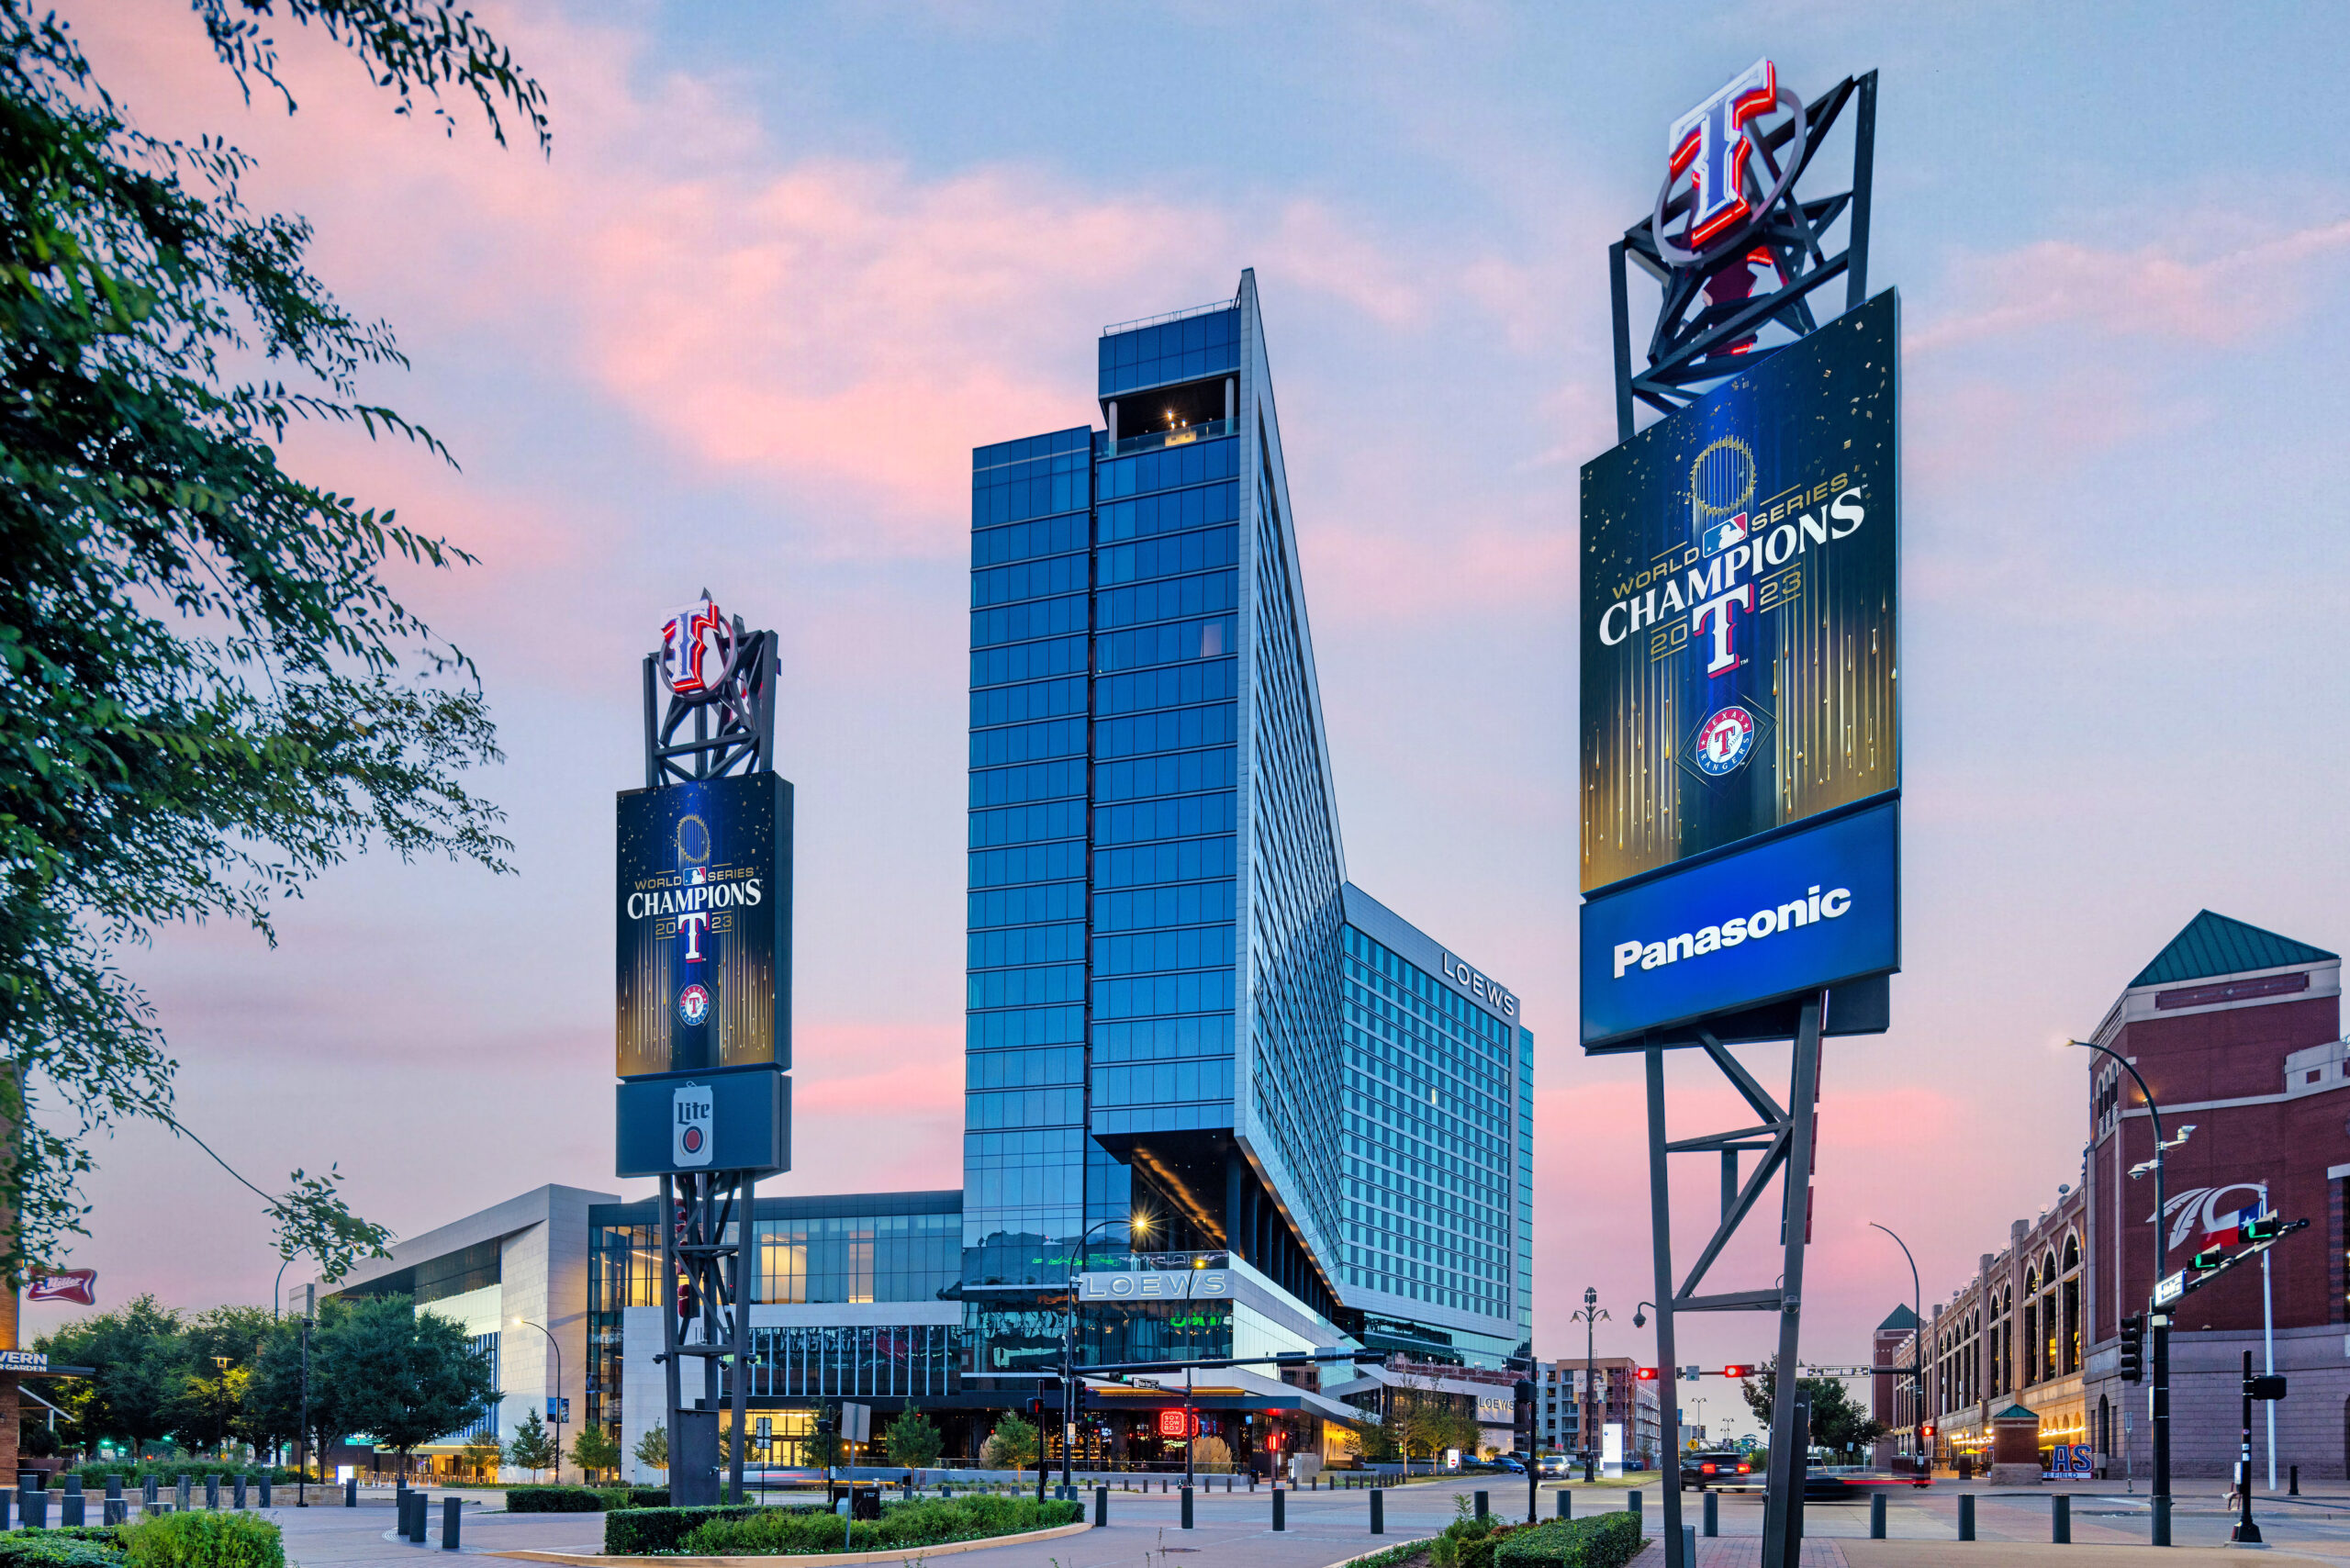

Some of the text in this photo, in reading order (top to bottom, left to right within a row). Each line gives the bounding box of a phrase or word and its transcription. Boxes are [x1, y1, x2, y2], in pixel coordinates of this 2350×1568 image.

[1668, 55, 1778, 249] T
[1612, 472, 1848, 599] WORLD SERIES
[1599, 487, 1865, 646] CHAMPIONS
[1651, 571, 1802, 679] 20 T 23
[1704, 711, 1746, 734] TEXAS
[1714, 724, 1736, 757] T
[1700, 737, 1750, 771] RANGERS
[634, 867, 755, 890] WORLD SERIES
[627, 879, 762, 920] CHAMPIONS
[655, 912, 733, 964] 20 T 23
[1614, 884, 1852, 979] Panasonic
[1442, 952, 1515, 1016] LOEWS
[677, 1102, 711, 1126] Lite
[1086, 1273, 1226, 1296] LOEWS
[1479, 1396, 1514, 1411] LOEWS
